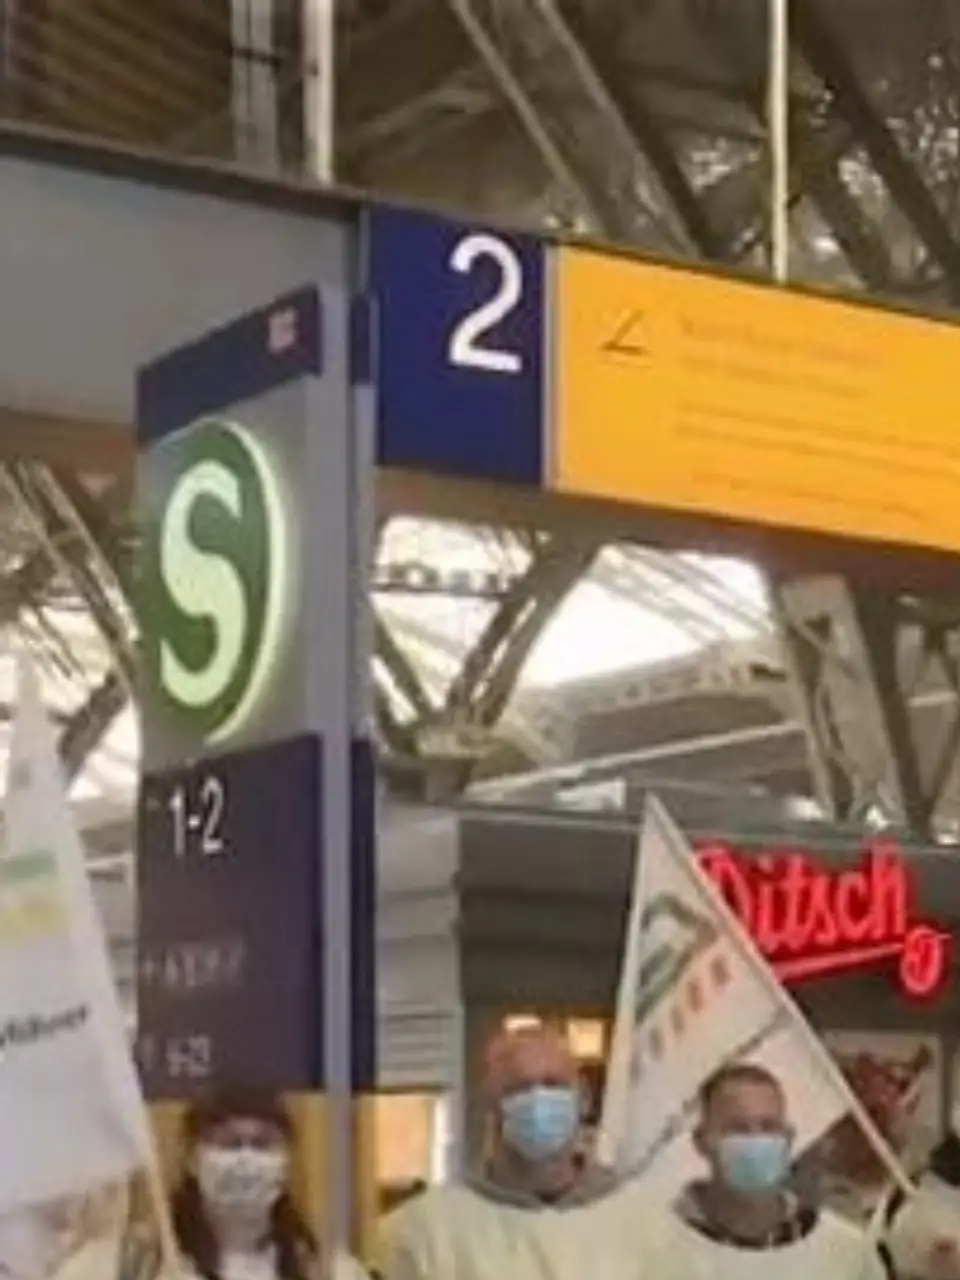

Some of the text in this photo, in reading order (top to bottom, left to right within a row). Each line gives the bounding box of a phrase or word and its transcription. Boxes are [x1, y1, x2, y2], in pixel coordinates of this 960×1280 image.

[449, 233, 524, 373] 2
[159, 458, 247, 708] S
[169, 775, 225, 856] 1-2
